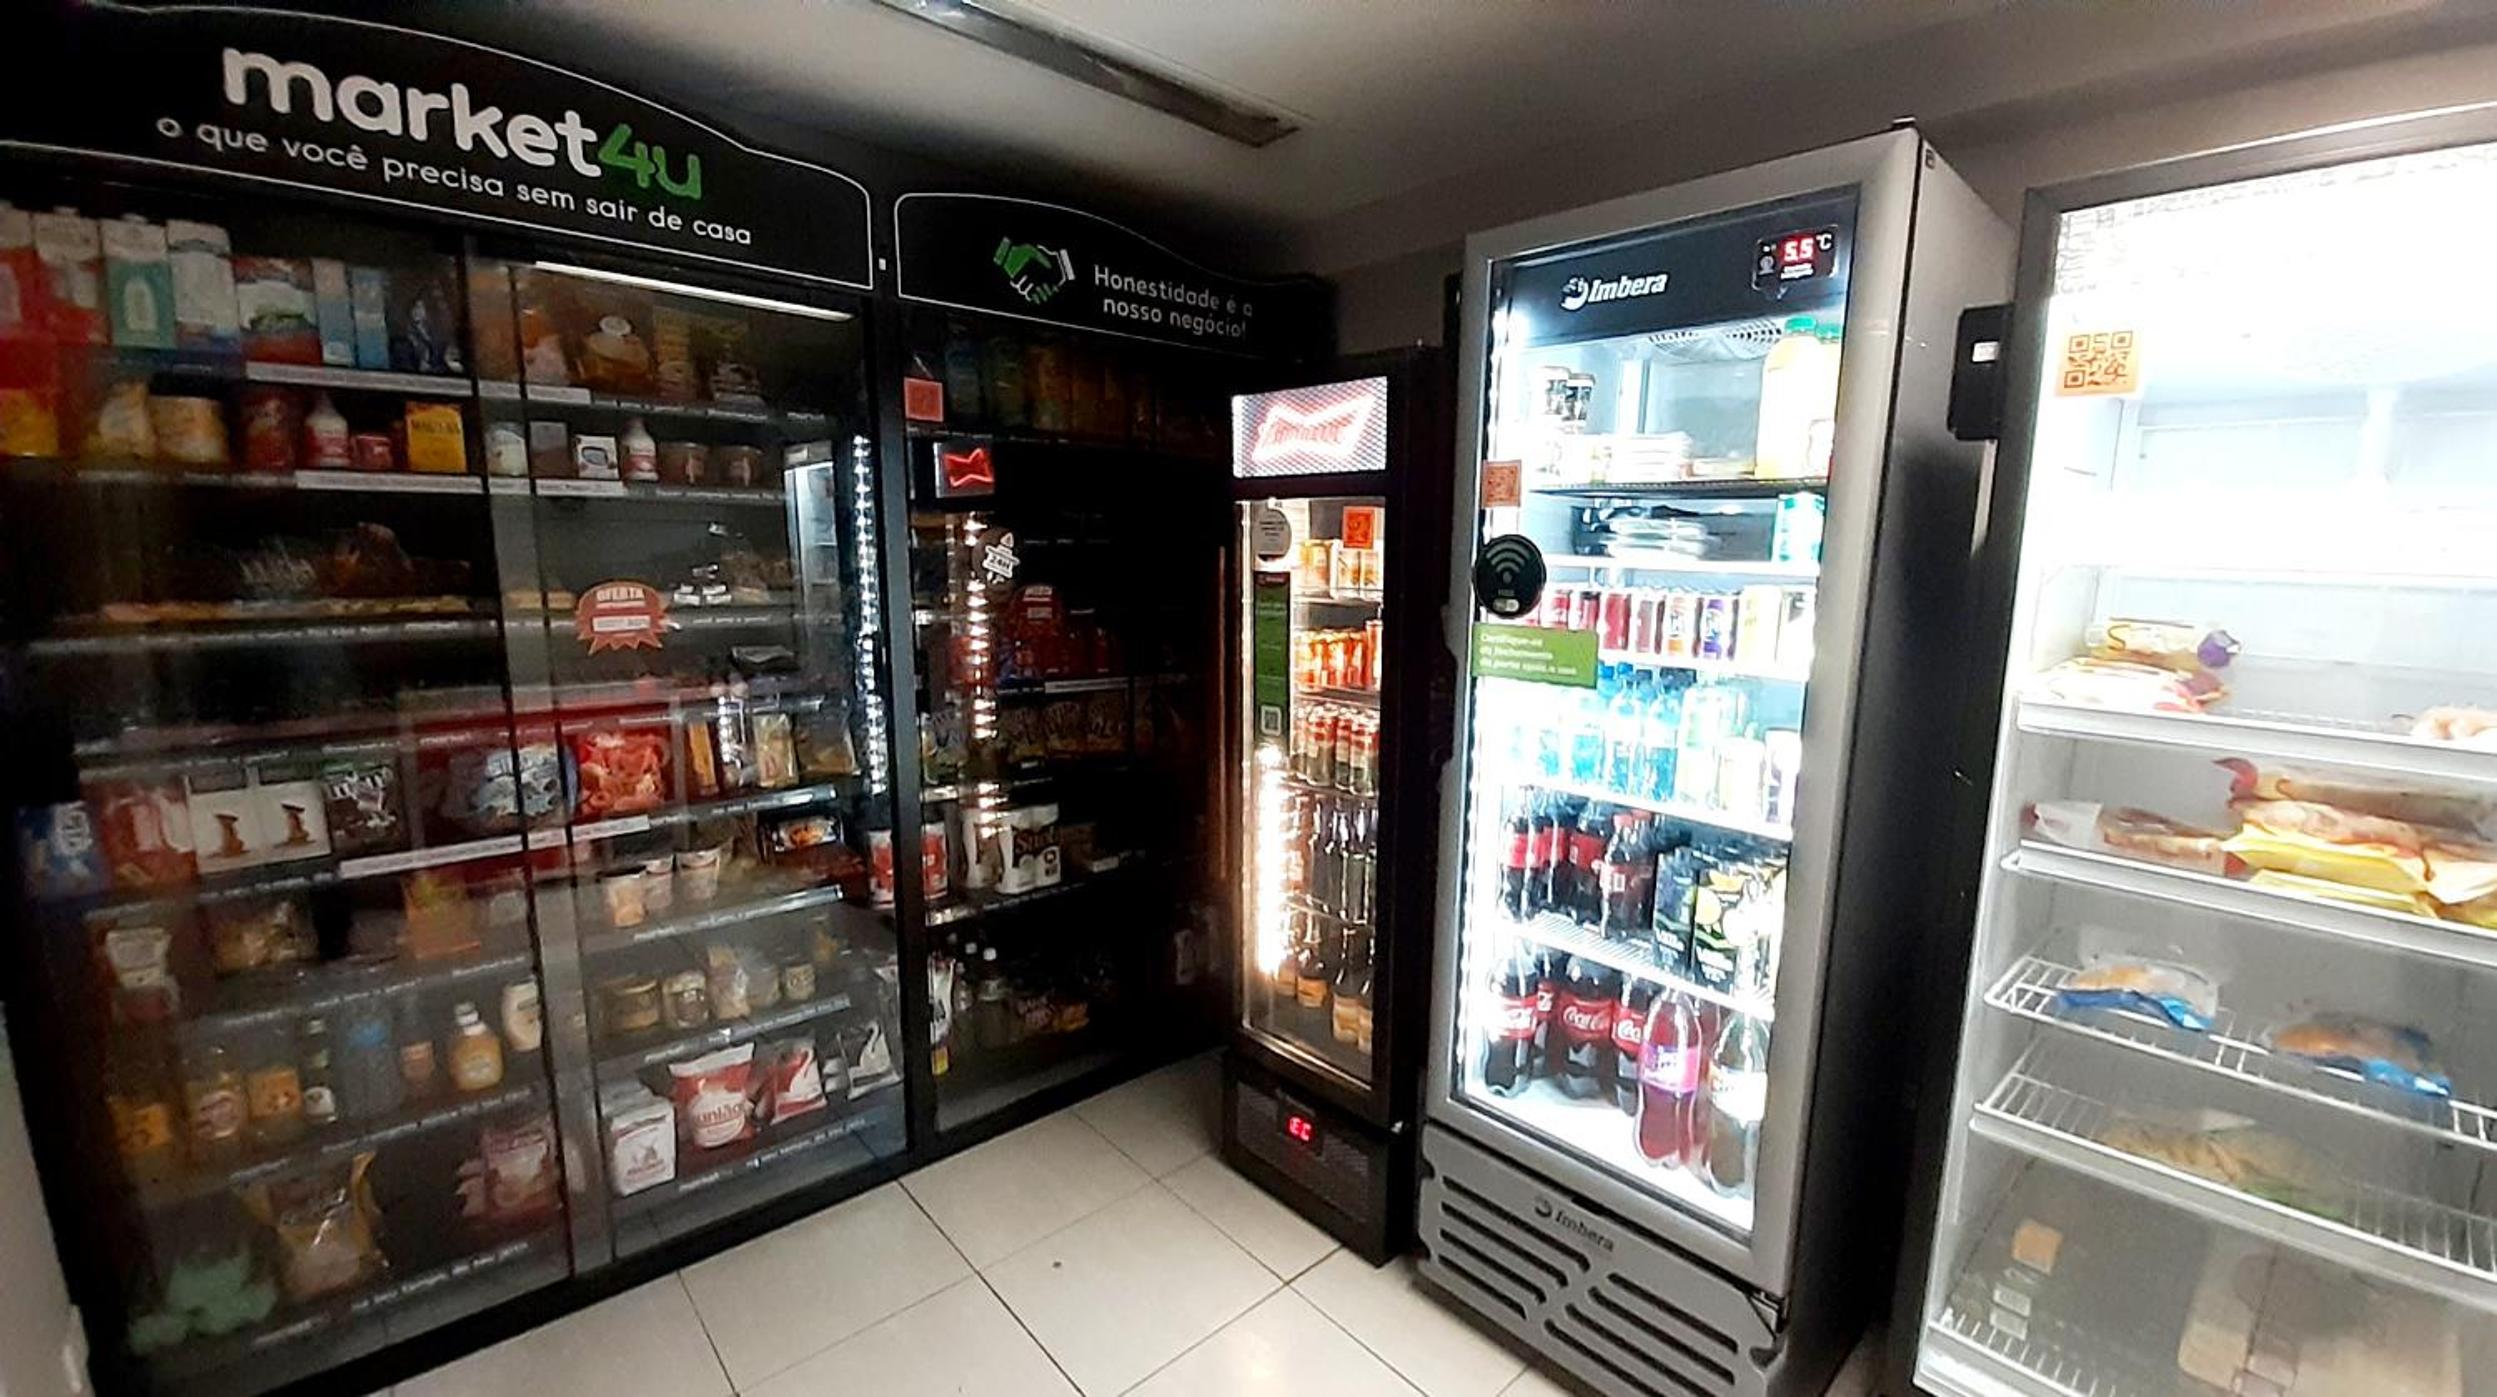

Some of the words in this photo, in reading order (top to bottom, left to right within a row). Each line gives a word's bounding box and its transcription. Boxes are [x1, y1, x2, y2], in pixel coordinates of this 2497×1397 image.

[222, 47, 702, 200] market4u
[156, 116, 182, 138] o
[197, 123, 268, 151] que
[281, 138, 369, 170] você
[383, 156, 504, 197] precisa
[516, 183, 576, 211] sem
[586, 198, 638, 222] sair
[648, 205, 683, 231] de
[692, 217, 751, 245] casa
[1094, 264, 1220, 310] Honestidade
[1226, 294, 1237, 314] é
[1242, 303, 1253, 318] a
[1587, 273, 1669, 303] Imbera
[1103, 298, 1163, 323] nosso
[1169, 311, 1247, 338] negócio!
[1556, 1210, 1614, 1252] Imbera
